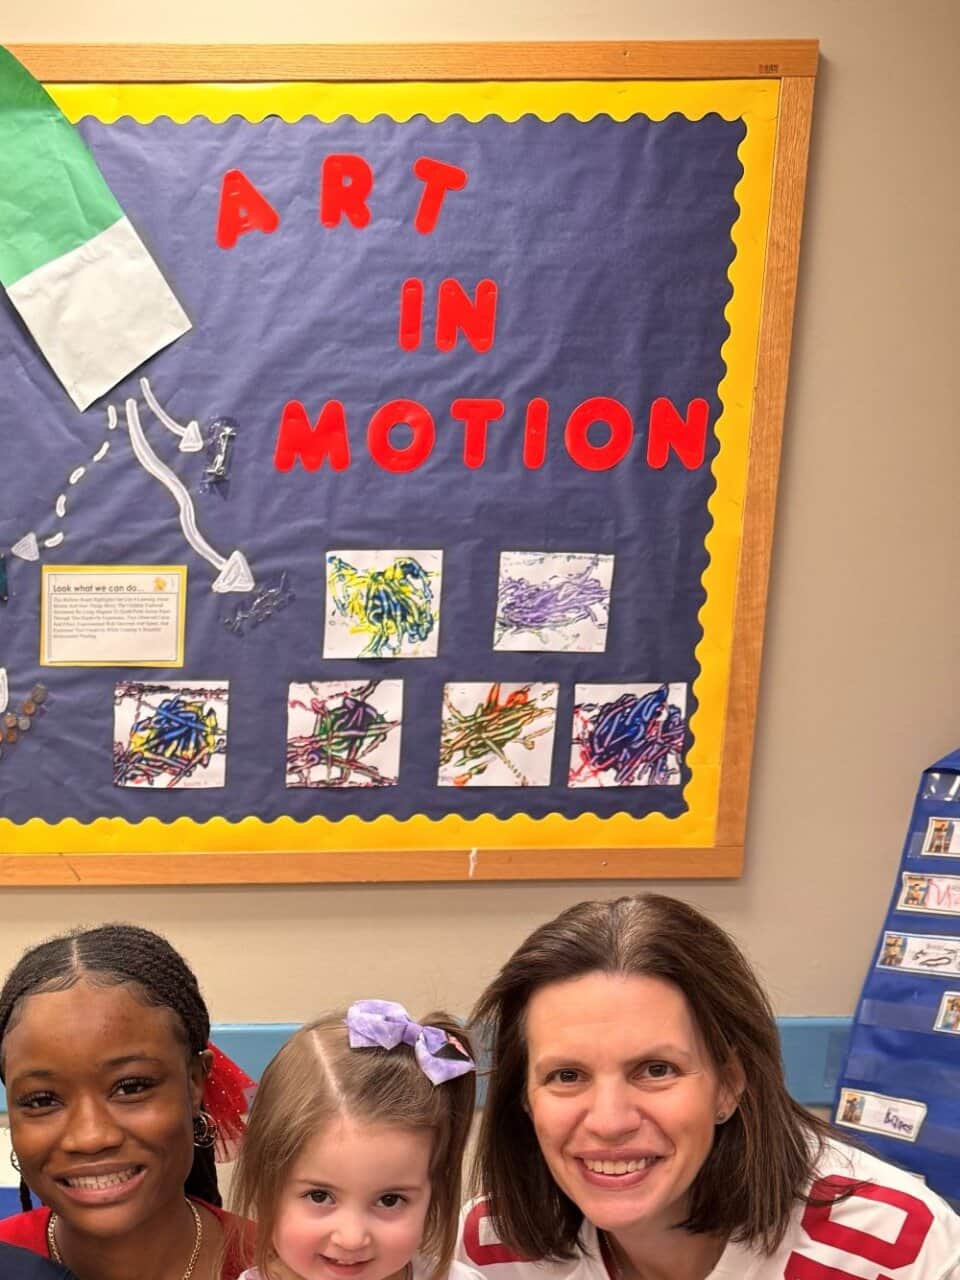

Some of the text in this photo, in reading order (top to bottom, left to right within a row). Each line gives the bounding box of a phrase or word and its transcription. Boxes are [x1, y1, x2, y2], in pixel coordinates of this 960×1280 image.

[215, 154, 468, 250] ART
[398, 278, 498, 352] IN
[273, 396, 710, 473] MOTION
[53, 584, 72, 593] Look
[74, 584, 93, 593] what
